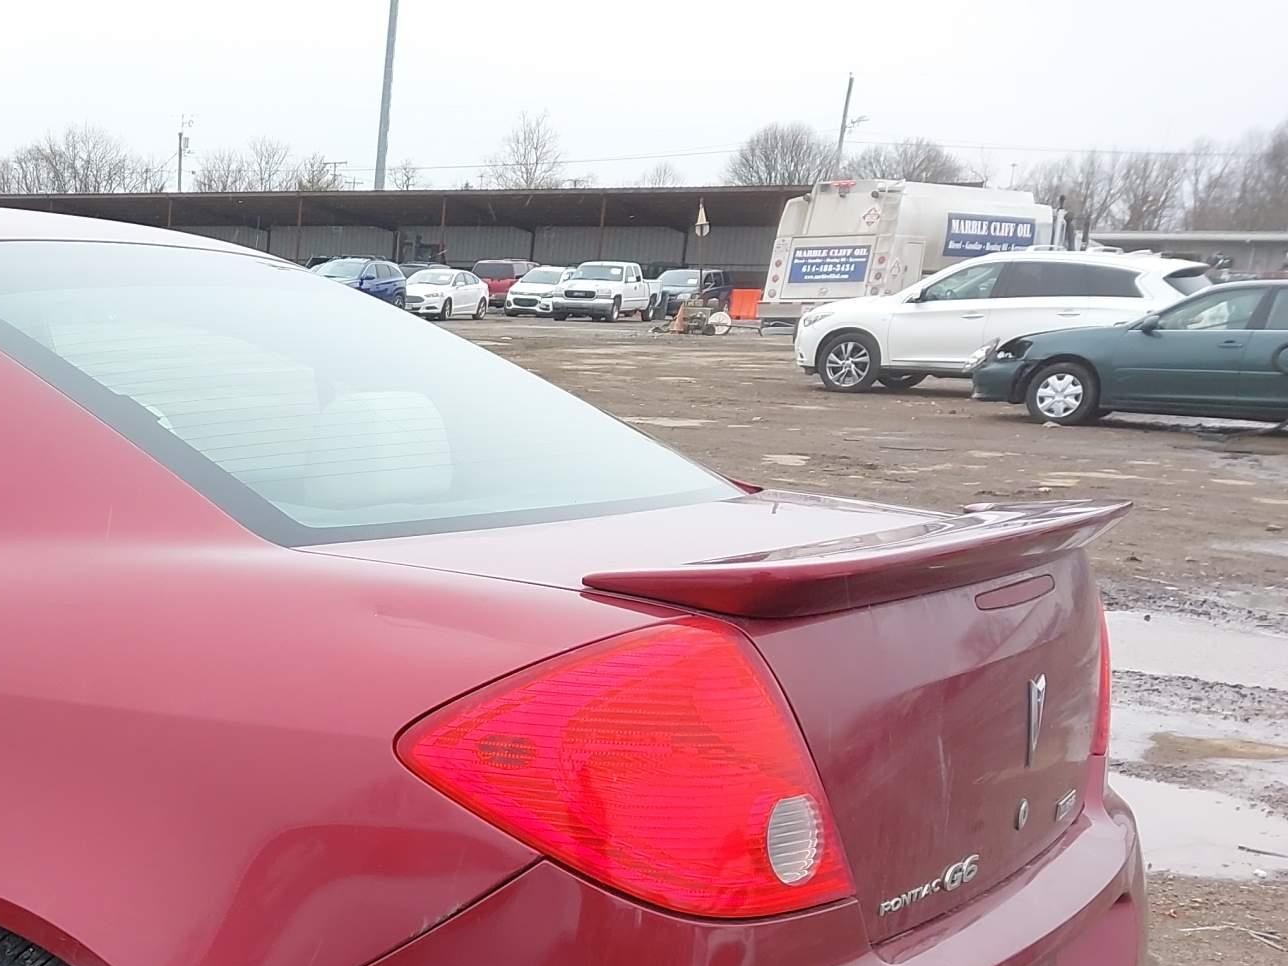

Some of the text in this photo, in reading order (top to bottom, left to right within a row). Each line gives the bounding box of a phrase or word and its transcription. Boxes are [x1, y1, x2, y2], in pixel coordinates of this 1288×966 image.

[951, 219, 1032, 238] MARBLE CLIFF OIL
[795, 248, 868, 257] MARBLE CLIFF OIL
[879, 854, 980, 917] PONTIAC G6
